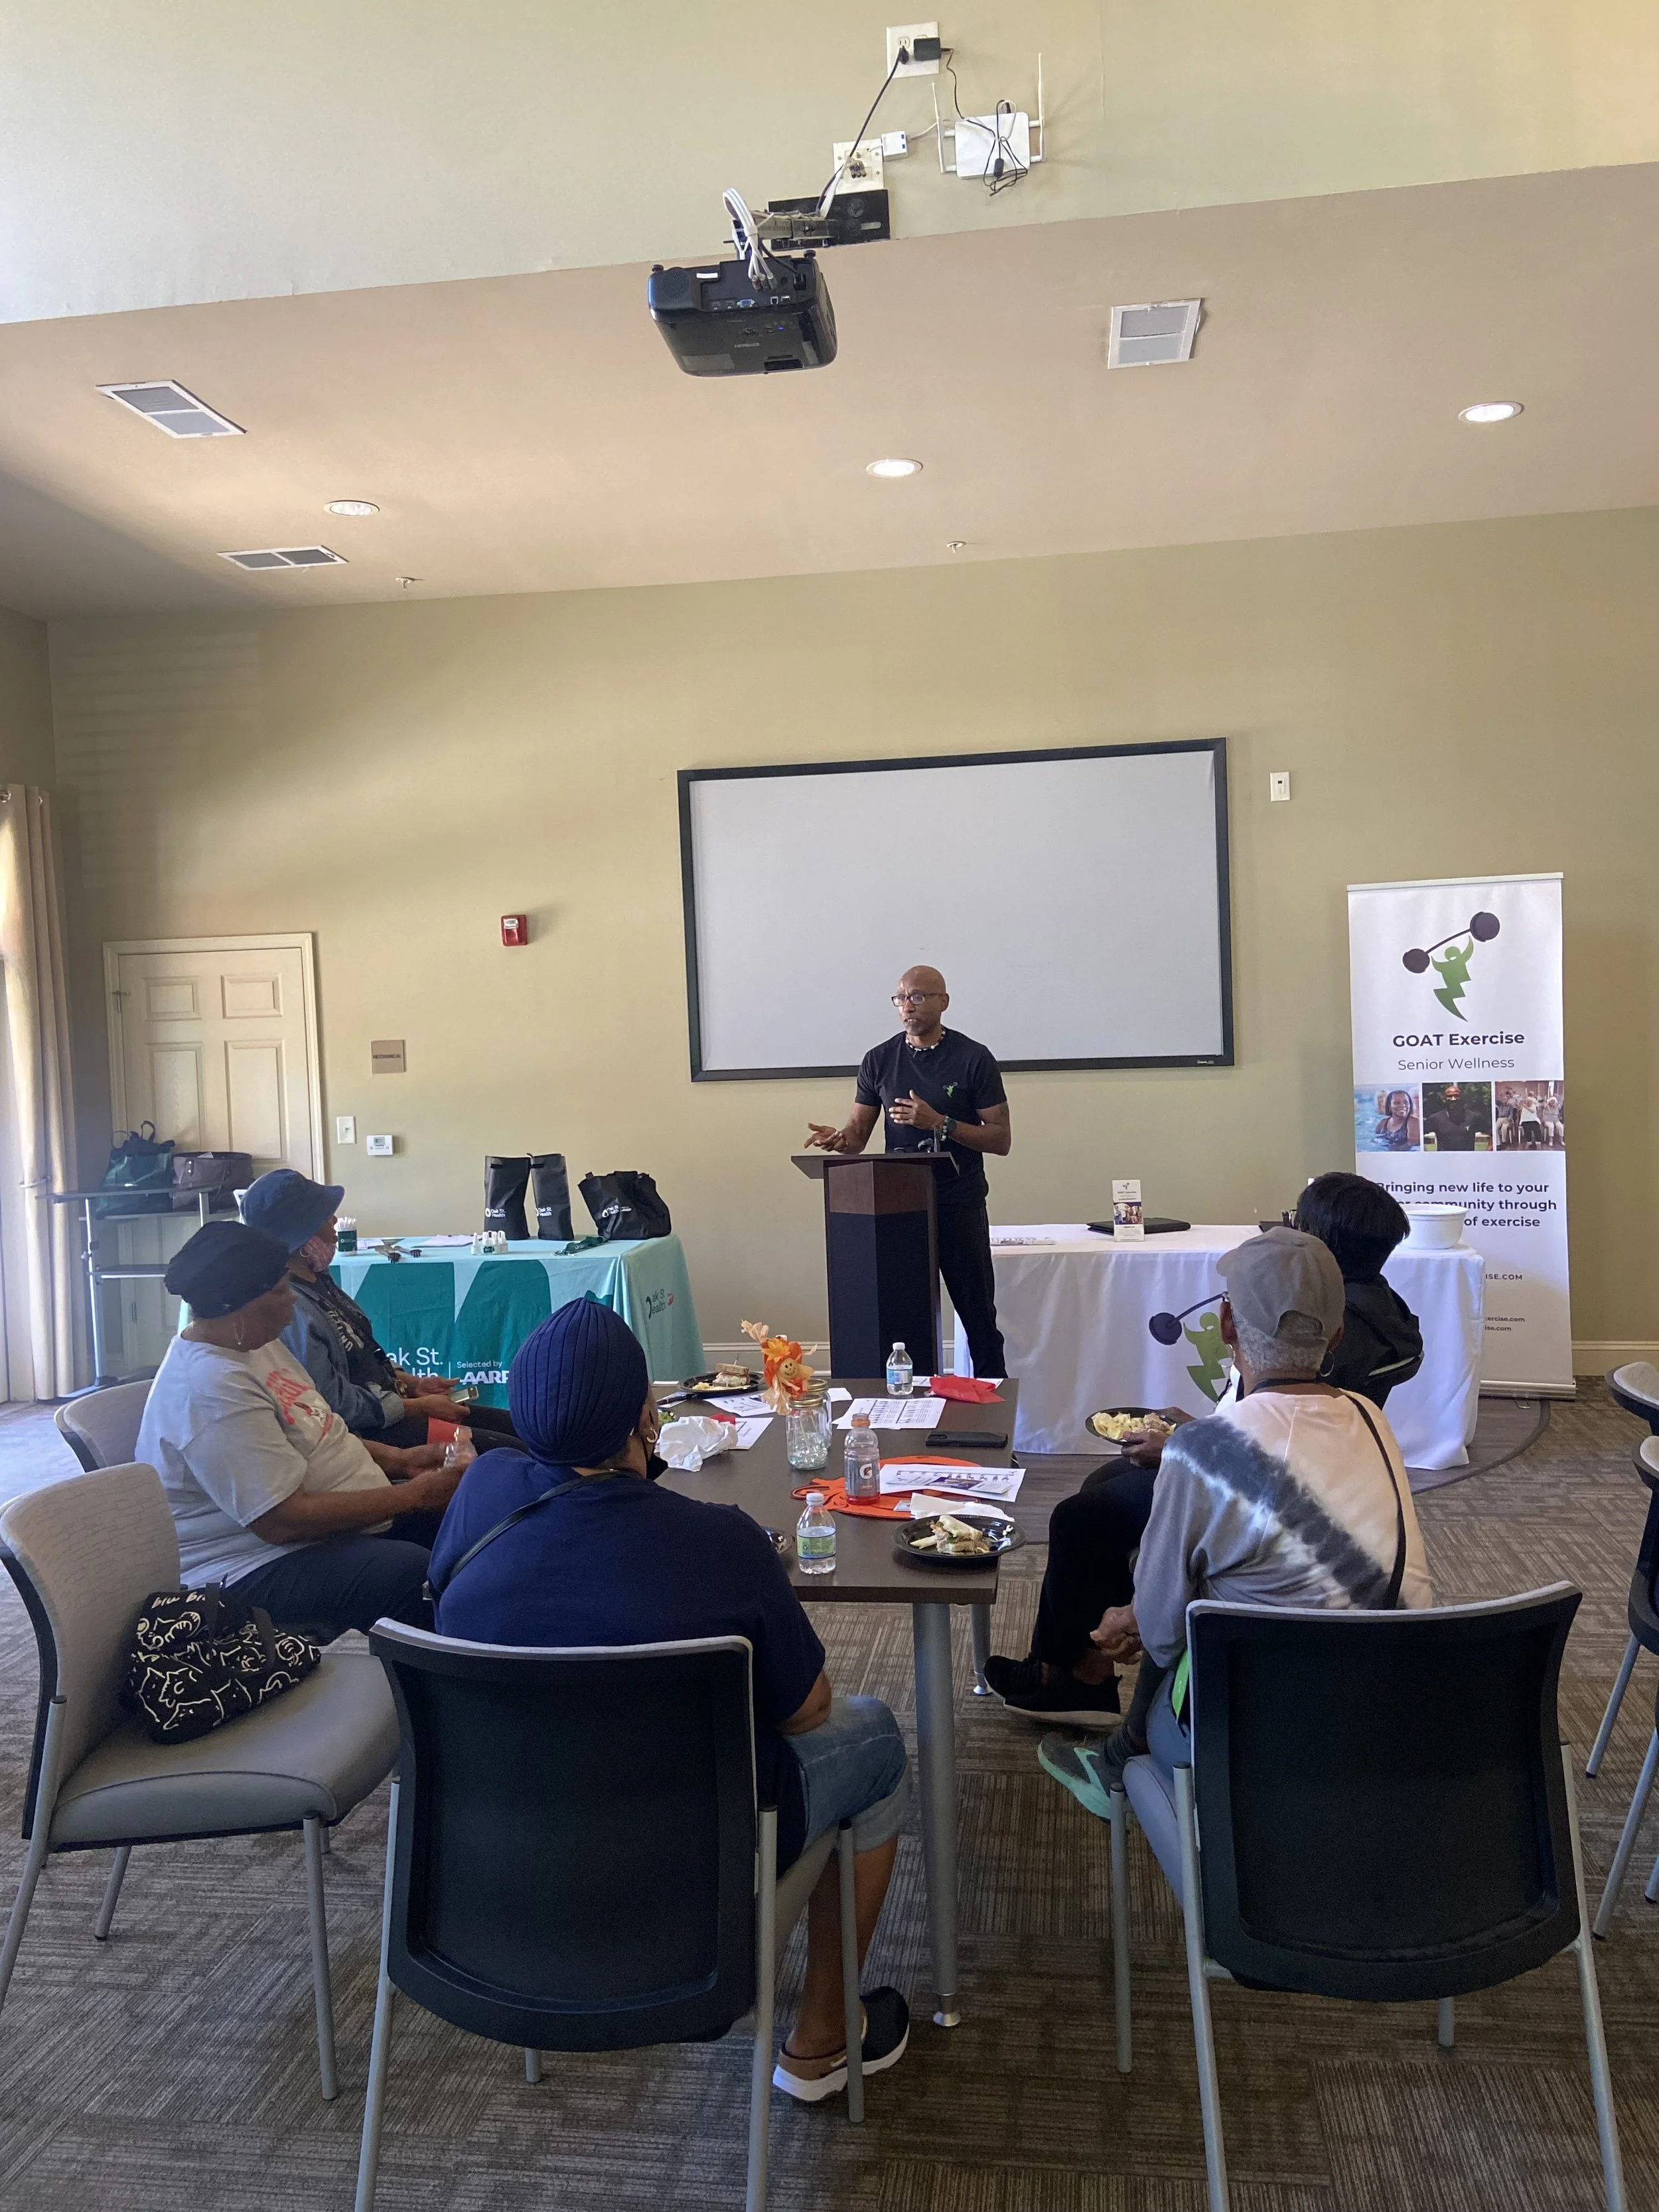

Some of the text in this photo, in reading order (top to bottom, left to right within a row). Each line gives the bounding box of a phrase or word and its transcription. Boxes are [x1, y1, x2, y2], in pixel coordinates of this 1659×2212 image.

[1392, 1031, 1525, 1047] GOAT Exercise
[1398, 1057, 1515, 1070] Senior Wellness
[1439, 1184, 1469, 1193] new
[1472, 1181, 1494, 1193] life
[1498, 1183, 1513, 1193] to
[1516, 1184, 1550, 1195] your
[1498, 1199, 1557, 1212] through
[1463, 1216, 1541, 1227] of exercise
[386, 1347, 443, 1366] ak St.
[457, 1360, 503, 1369] Selected by
[859, 1463, 873, 1479] G
